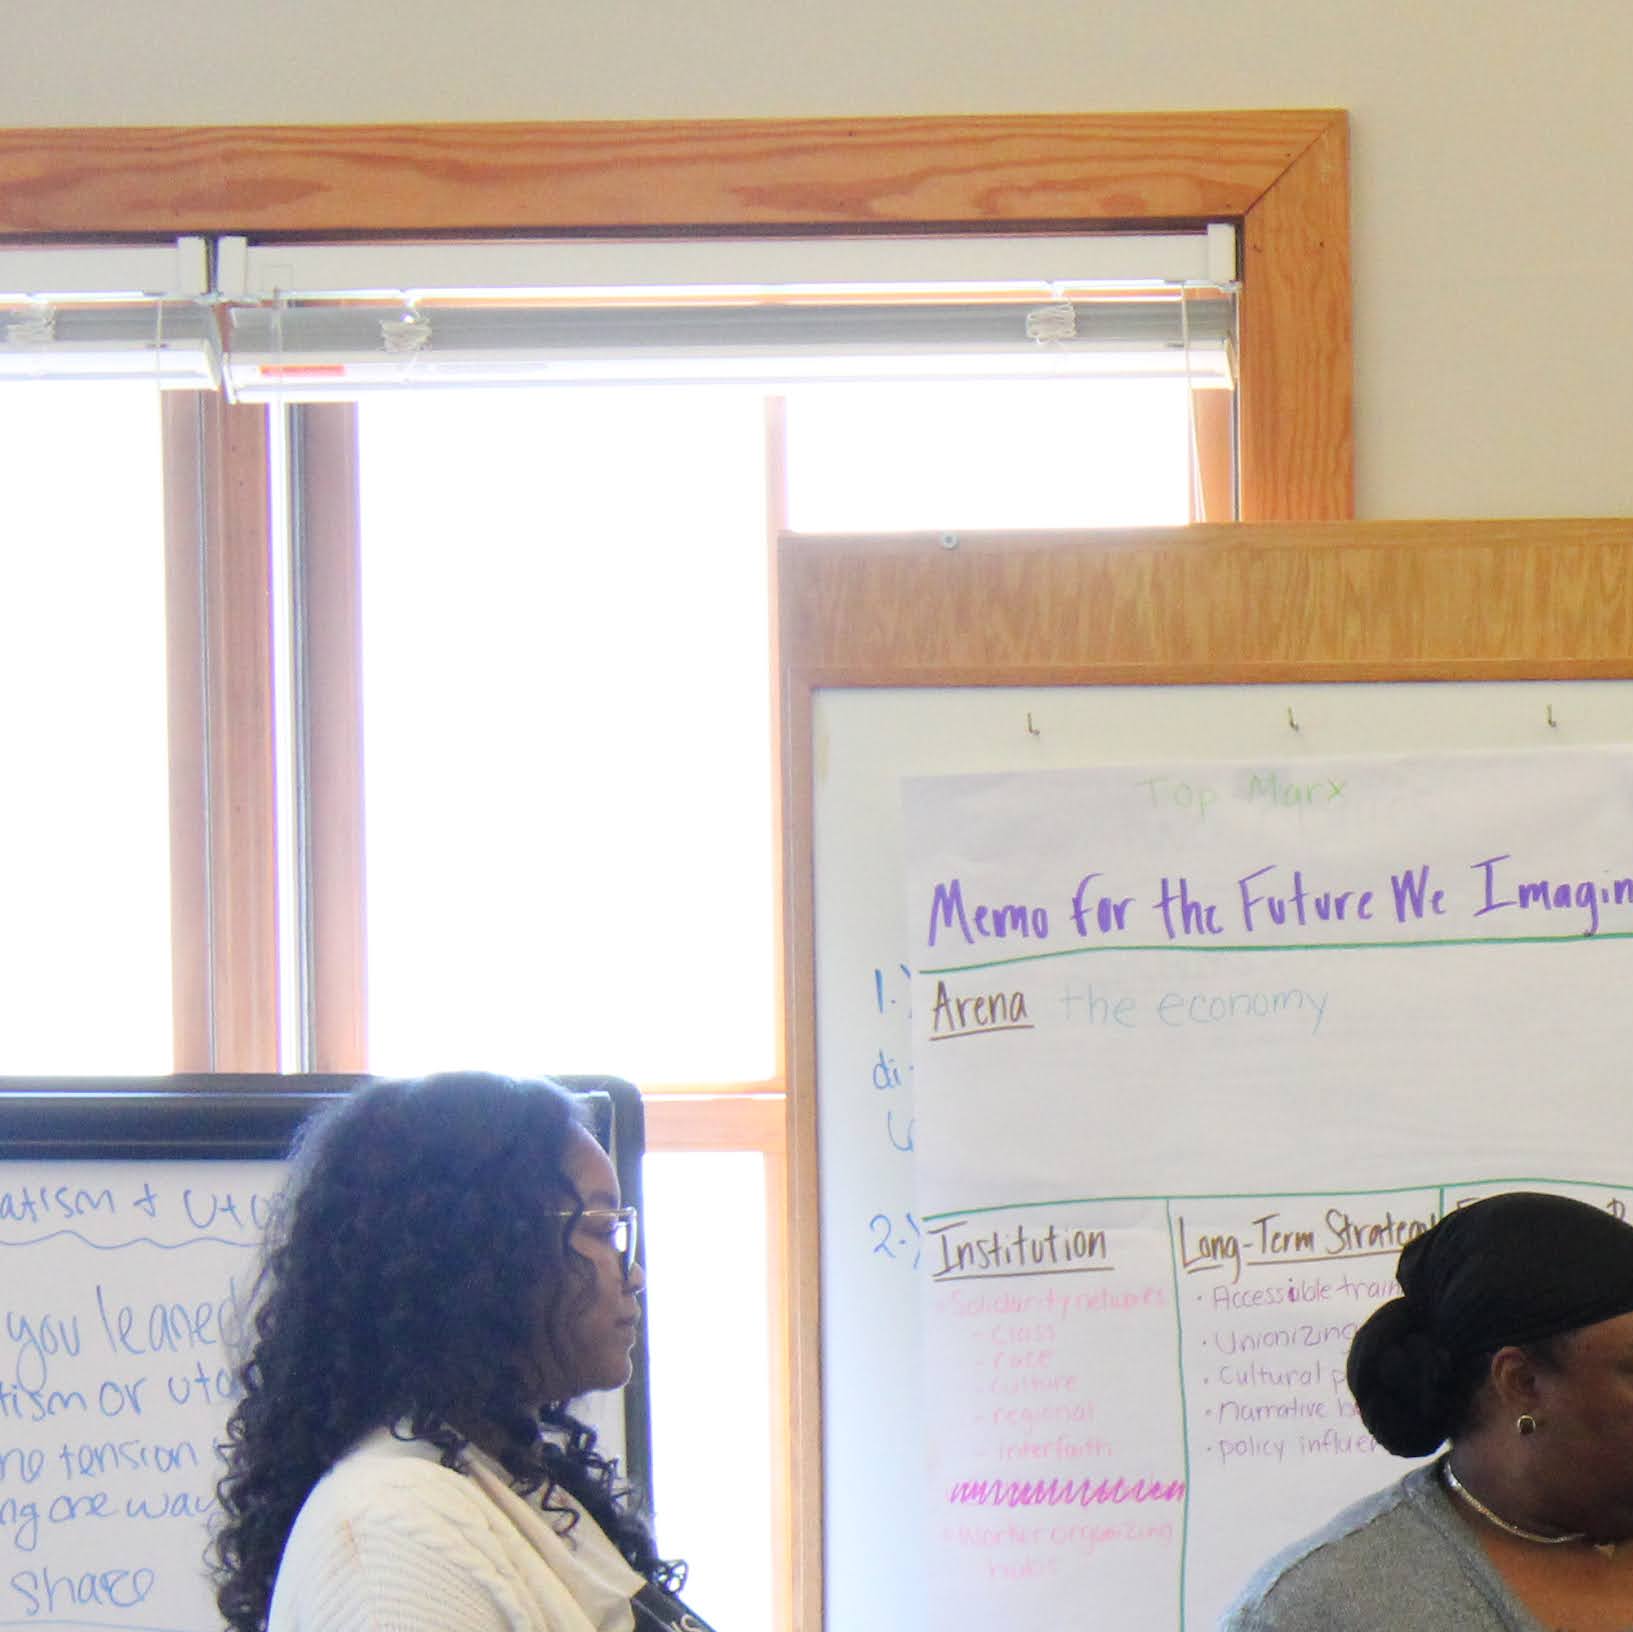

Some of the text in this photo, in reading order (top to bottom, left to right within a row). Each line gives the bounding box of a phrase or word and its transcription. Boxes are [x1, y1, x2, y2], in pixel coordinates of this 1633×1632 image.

[927, 881, 1049, 947] Memo
[1071, 872, 1136, 937] for
[1152, 877, 1225, 940] the
[1238, 864, 1375, 932] Future
[1389, 863, 1447, 924] We
[932, 980, 1029, 1032] Arena
[1060, 985, 1330, 1036] the economy
[927, 1221, 1108, 1278] Institution
[1179, 1213, 1315, 1286] Long-Term
[1213, 1277, 1330, 1312] Accessible
[7, 1311, 80, 1394] you
[101, 1379, 146, 1417] or
[1218, 1437, 1288, 1464] policy
